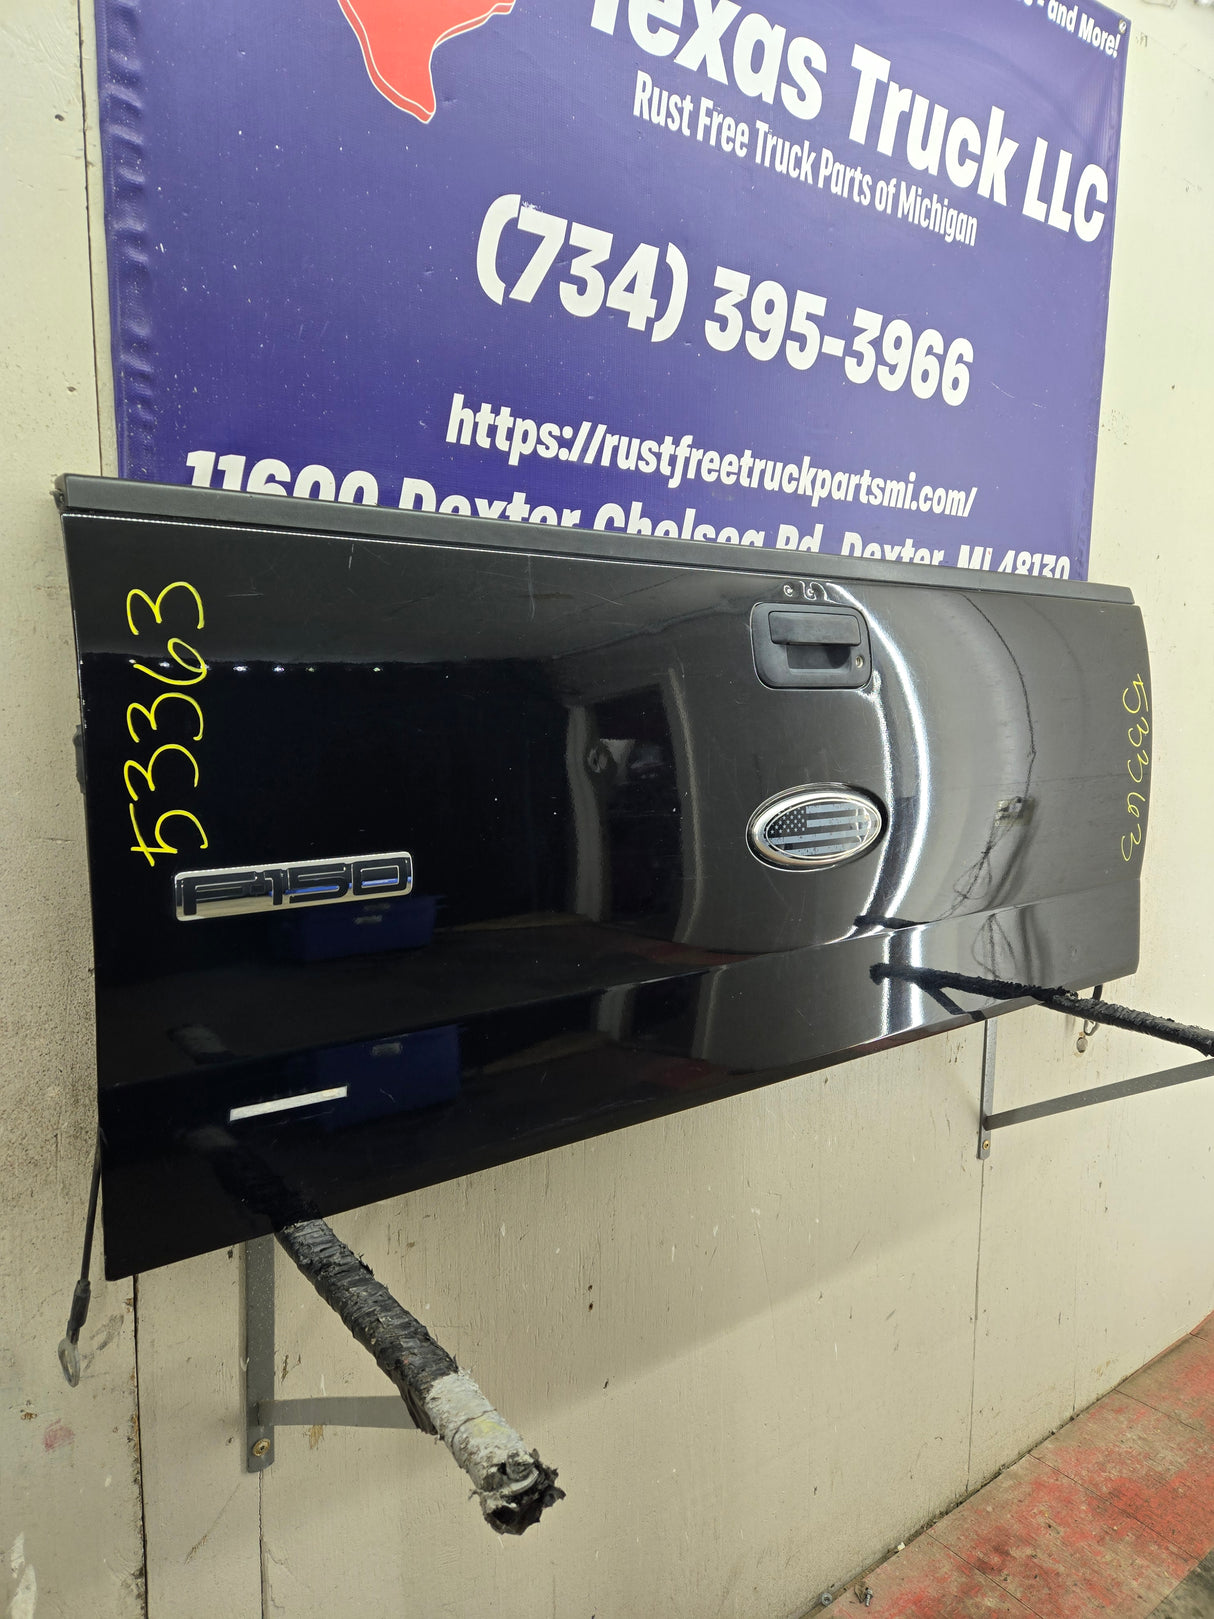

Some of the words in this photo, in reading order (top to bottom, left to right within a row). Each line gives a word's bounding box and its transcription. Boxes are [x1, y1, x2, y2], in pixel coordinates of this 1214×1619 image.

[1047, 0, 1078, 33] and
[1078, 13, 1121, 58] More!
[633, 70, 693, 136] Rust
[696, 96, 749, 158] Free
[755, 119, 816, 185] Truck
[817, 147, 872, 206] Parts
[874, 178, 897, 214] of
[897, 180, 978, 246] Michigan
[848, 44, 1020, 206] Truck
[1022, 136, 1109, 243] LLC
[476, 194, 689, 342] (734)
[705, 266, 974, 406] 395-3966
[186, 450, 379, 507] 11600
[445, 392, 977, 517] https://rustfreetruckpartsmi.com/
[123, 581, 208, 867] 53363
